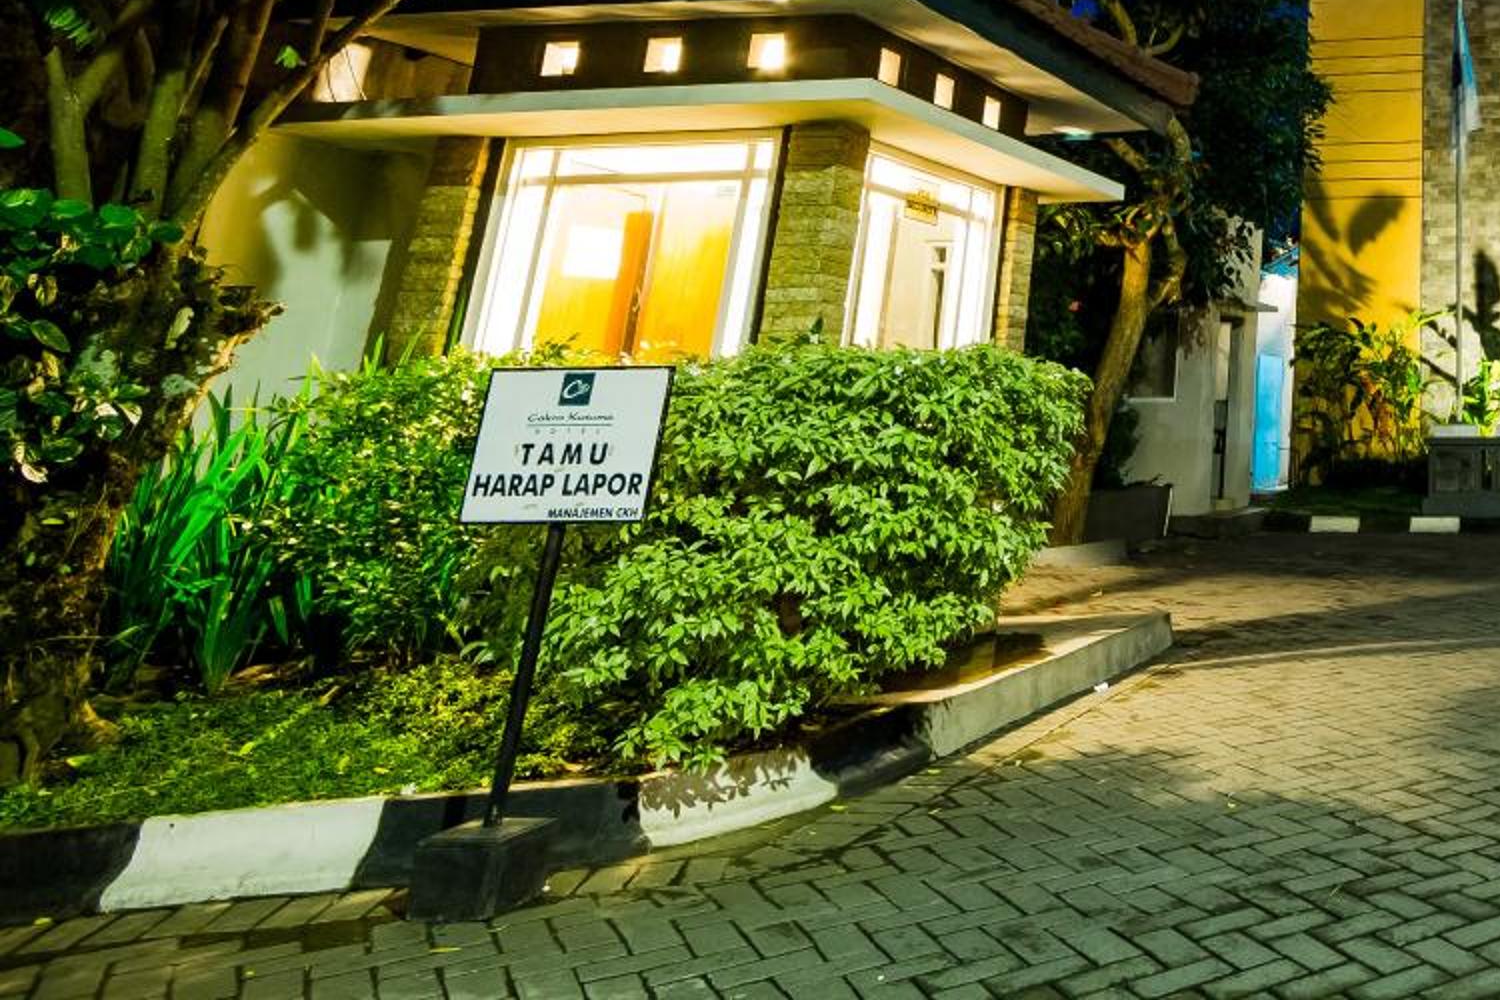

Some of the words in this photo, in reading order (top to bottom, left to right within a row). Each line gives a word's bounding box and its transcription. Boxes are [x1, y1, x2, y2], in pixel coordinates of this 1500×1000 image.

[521, 443, 608, 465] TAMU
[472, 474, 554, 496] HARAP
[562, 473, 643, 496] LAPOR
[548, 507, 613, 518] MANAJEMEN
